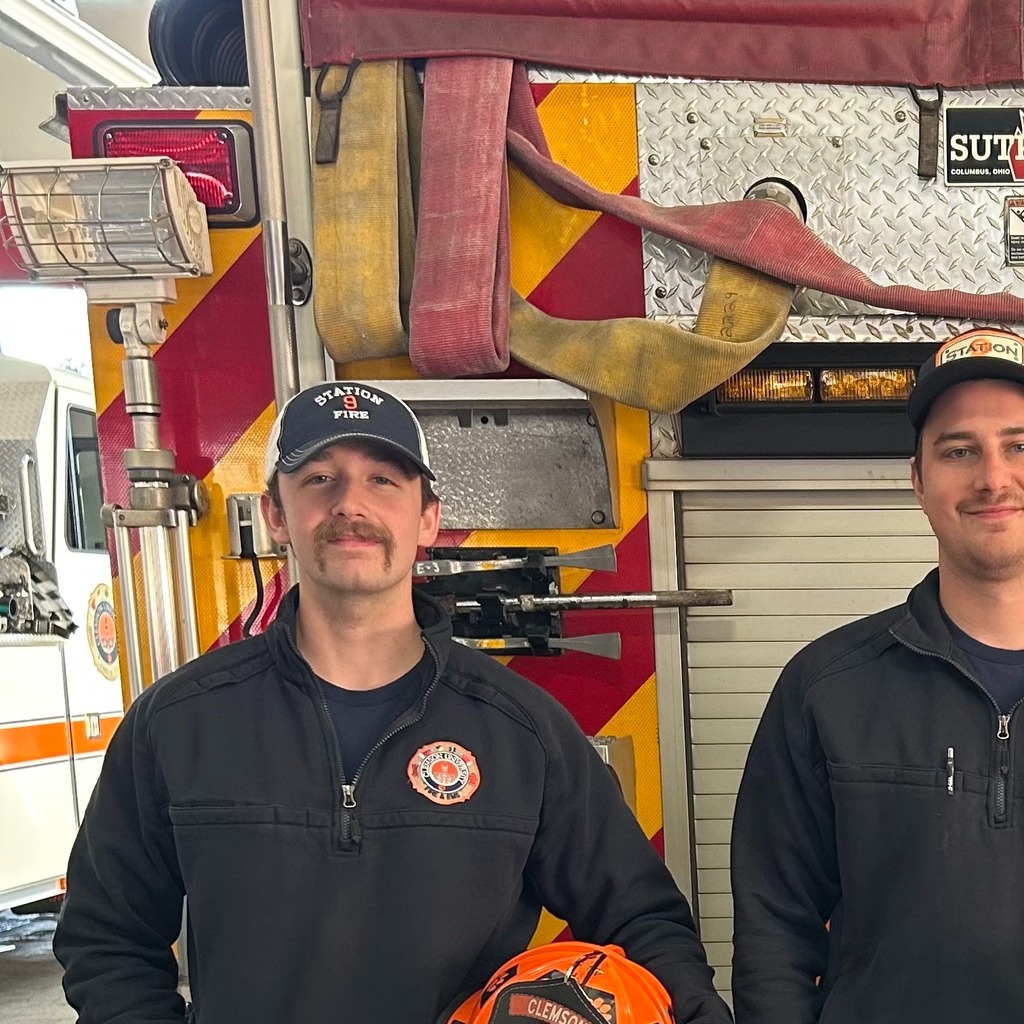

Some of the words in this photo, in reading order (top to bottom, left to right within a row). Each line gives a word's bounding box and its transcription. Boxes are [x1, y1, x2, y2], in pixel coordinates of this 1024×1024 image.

[950, 168, 991, 176] COLUMBUS,
[942, 343, 1018, 361] STATION
[314, 386, 385, 407] STATION
[343, 395, 358, 410] 9
[333, 410, 370, 419] FIRE
